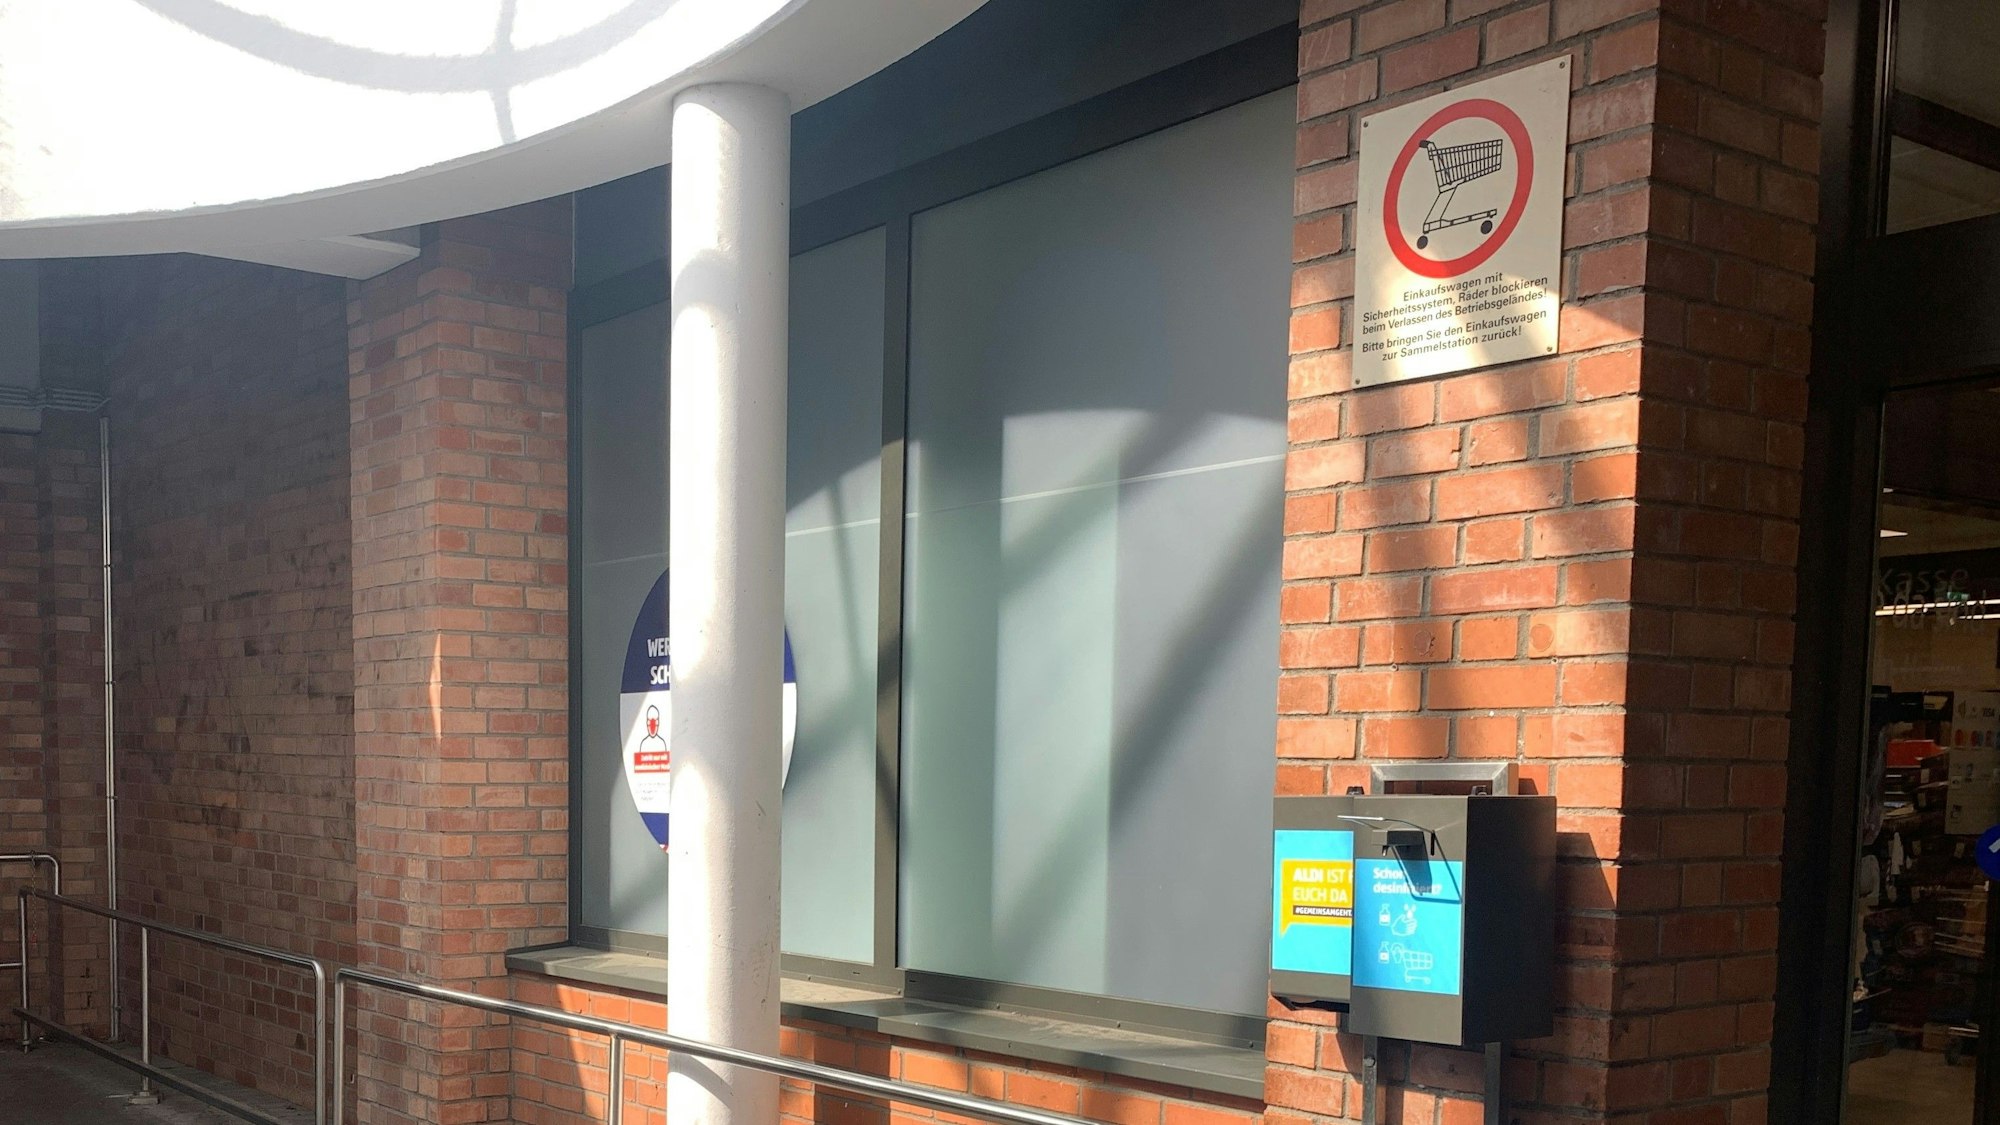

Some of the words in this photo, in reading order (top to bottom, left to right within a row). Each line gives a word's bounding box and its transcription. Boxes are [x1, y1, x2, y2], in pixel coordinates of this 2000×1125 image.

[1363, 296, 1456, 322] Sicherheitssystem,
[1458, 288, 1488, 303] Räder
[1491, 276, 1548, 296] blockieren
[1403, 278, 1482, 302] Einkaufswagen
[1485, 272, 1503, 285] mit
[1362, 322, 1386, 335] beim
[1388, 313, 1433, 329] Verlassen
[1435, 309, 1453, 320] des
[1454, 288, 1547, 316] Betriebsgeländes!
[1362, 341, 1385, 353] Bitte
[1386, 333, 1424, 349] bringen
[1426, 329, 1442, 340] Sie
[1444, 326, 1463, 337] den
[1465, 309, 1547, 333] Einkaufswagen
[1382, 351, 1397, 361] zur
[1400, 335, 1479, 358] Sammelstation
[1481, 325, 1522, 342] zurück!
[1294, 868, 1323, 882] ALDI
[1327, 868, 1346, 884] IST
[1292, 886, 1327, 902] EUCH
[1330, 888, 1349, 903] DA
[1296, 907, 1352, 916] #GEMEINSAMGEHT
